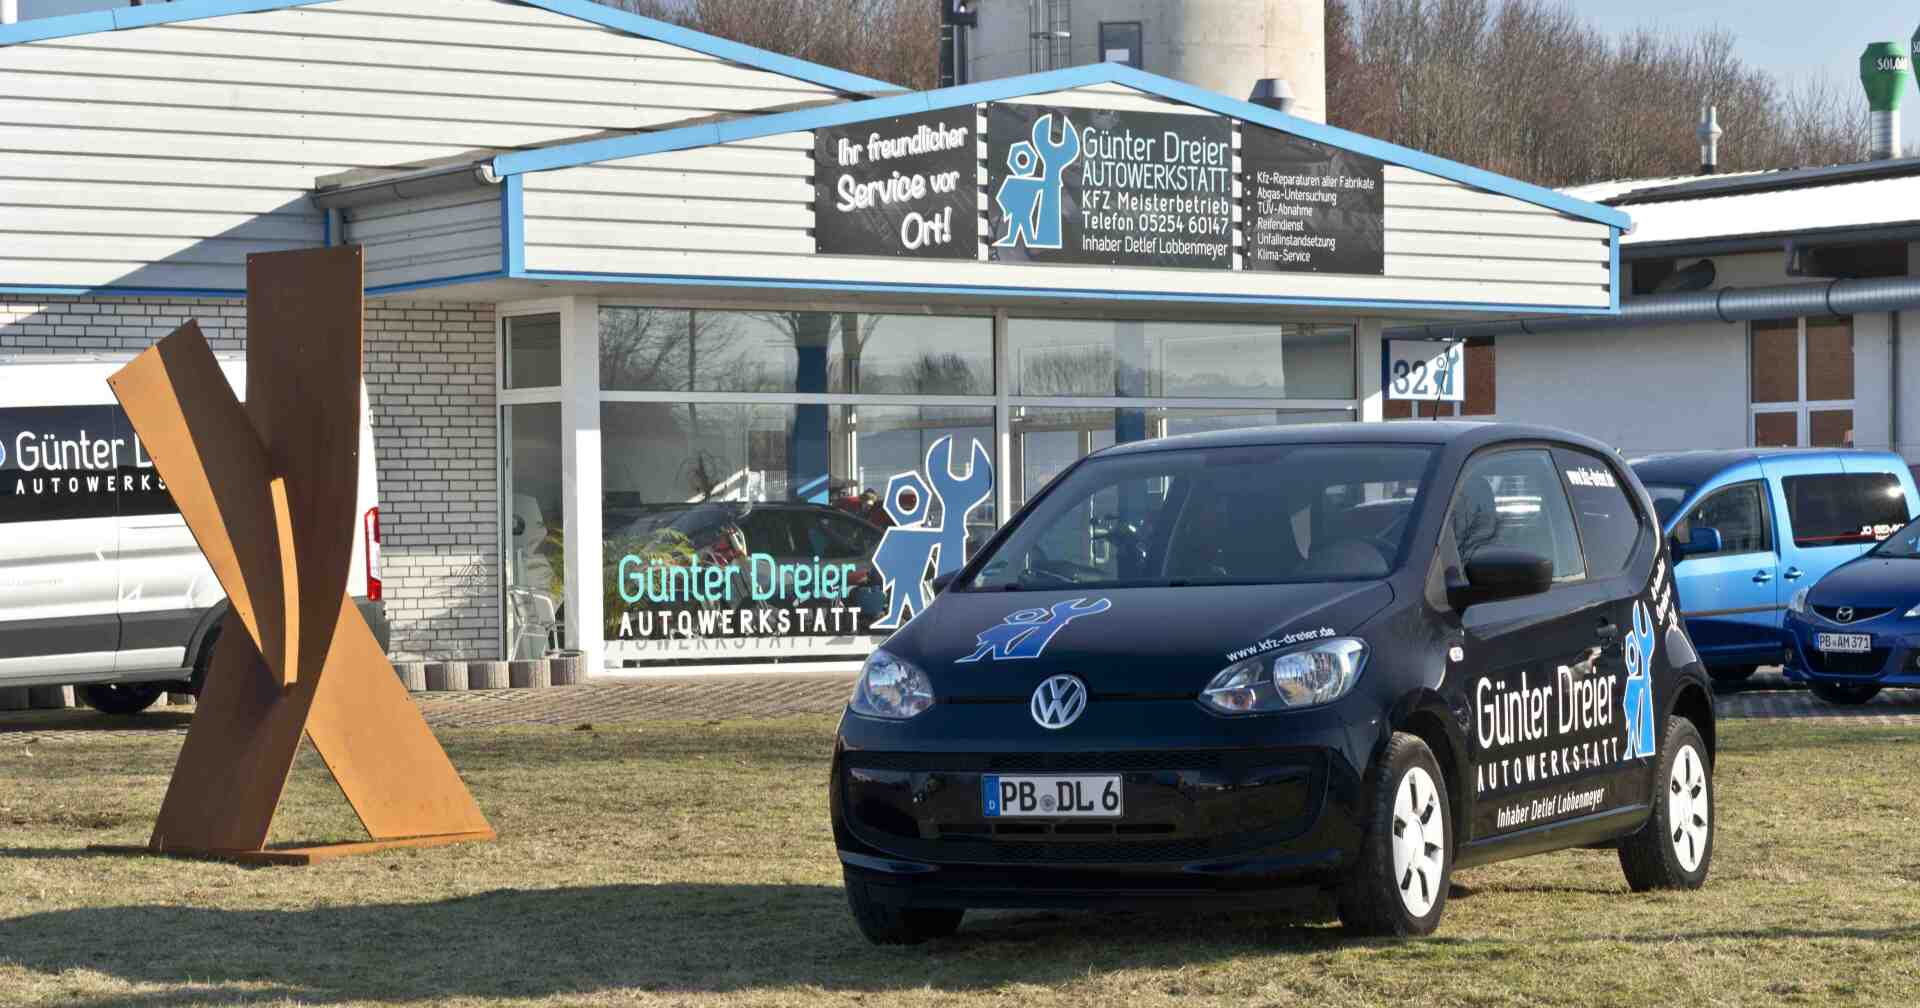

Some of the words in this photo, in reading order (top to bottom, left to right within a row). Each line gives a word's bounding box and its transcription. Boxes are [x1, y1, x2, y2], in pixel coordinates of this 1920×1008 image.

[838, 138, 863, 166] Ihr
[867, 122, 968, 161] freundlicher
[1082, 126, 1156, 161] Günter
[1164, 131, 1228, 165] Dreier
[837, 171, 926, 212] Service
[930, 170, 960, 193] vor
[1082, 160, 1228, 192] AUTOWERKSTATT
[1257, 171, 1320, 188] Kfz-Reparaturen
[1321, 176, 1337, 188] aller
[1340, 176, 1375, 190] Fabrikate
[1082, 190, 1111, 210] KFZ
[1118, 191, 1229, 215] Meisterbetrieb
[1257, 186, 1337, 206] Abgas-Untersuchung
[901, 206, 952, 249] Ort!
[1082, 210, 1134, 231] Telefon
[1139, 214, 1184, 233] 05254
[1188, 217, 1229, 235] 60147
[1257, 216, 1304, 231] Reifendienst
[1082, 234, 1121, 252] Inhaber
[1124, 236, 1157, 253] Detlef
[1160, 238, 1228, 260] Lobbenmeyer
[1257, 231, 1336, 251] Unfallinstandsetzung
[1257, 247, 1311, 262] Klima-Service
[1393, 360, 1427, 394] 32
[16, 430, 124, 471] Günter
[617, 553, 743, 603] Günter
[751, 553, 856, 601] Dreier
[619, 607, 862, 637] AUTOWERKSTATT
[1226, 626, 1336, 662] www.kfz-dreier.de
[1820, 635, 1831, 648] PB
[1838, 636, 1850, 649] AM
[1851, 636, 1869, 649] 371
[1476, 671, 1552, 749] Günter
[1558, 665, 1616, 734] Dreier
[1477, 737, 1618, 793] AUTOWERKSTATT
[1000, 781, 1038, 811] PB
[1056, 781, 1094, 811] DL
[1102, 781, 1119, 811] 6
[1497, 805, 1529, 829] Inhaber
[1531, 796, 1556, 821] Detlef
[1557, 788, 1604, 814] Lobbenmeyer
